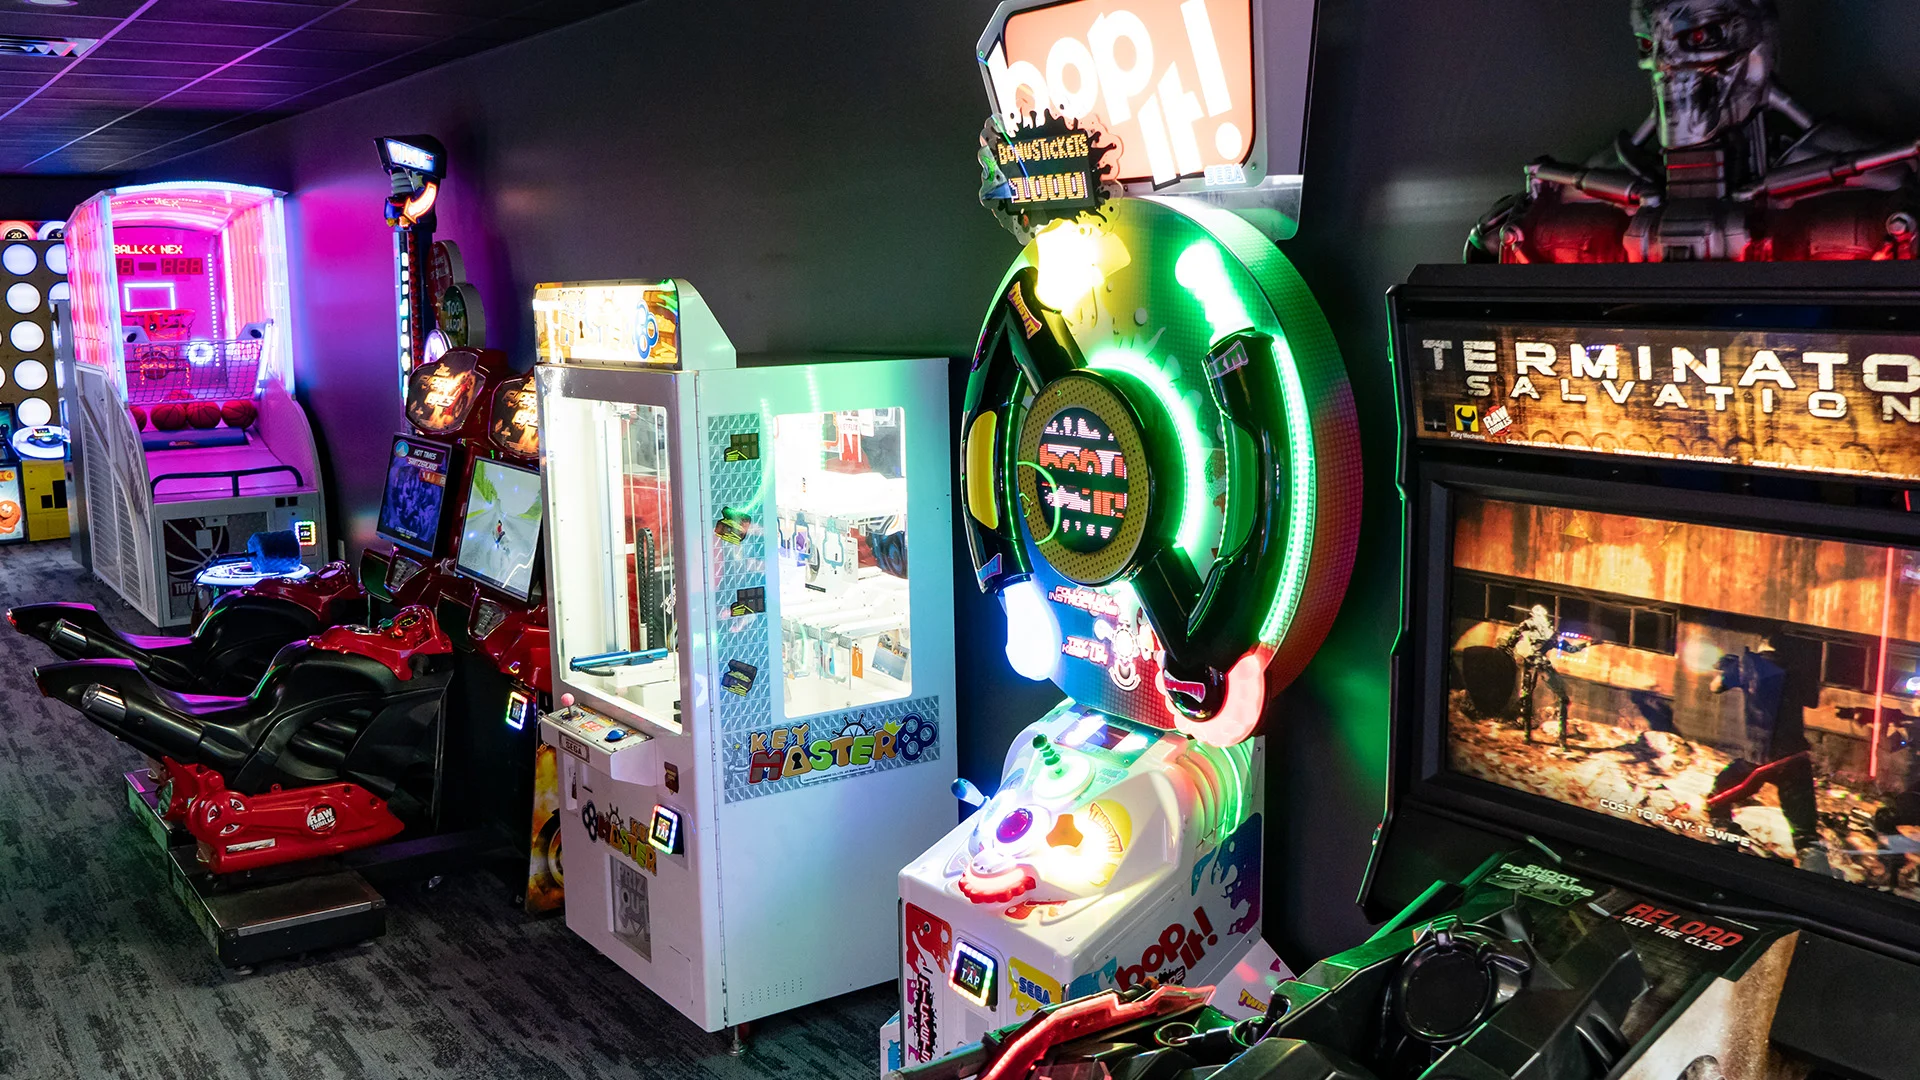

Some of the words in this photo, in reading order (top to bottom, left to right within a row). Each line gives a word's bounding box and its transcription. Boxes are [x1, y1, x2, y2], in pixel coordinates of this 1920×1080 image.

[1008, 171, 1088, 203] 1000
[1204, 164, 1246, 186] SEGA
[160, 244, 183, 255] NEX
[1422, 338, 1920, 394] TERMINATO
[1466, 375, 1920, 424] SALVATION
[1482, 405, 1509, 428] RAW
[1488, 417, 1514, 436] THRILLS
[413, 448, 424, 457] HOT
[565, 741, 582, 756] SEGA
[751, 723, 809, 753] KEY
[749, 730, 898, 784] MASTER
[309, 807, 333, 824] RAW
[1600, 798, 1633, 814] COST
[1636, 808, 1653, 820] TO
[1655, 814, 1696, 832] PLAY:
[1705, 828, 1751, 848] SWIPE
[619, 865, 648, 893] PRIZ
[1500, 862, 1558, 885] POWER
[1560, 881, 1596, 897] UPS
[1526, 864, 1580, 884] SHOOT
[1621, 915, 1652, 929] HIT
[1654, 925, 1684, 940] THE
[1684, 936, 1724, 952] CLIP
[1625, 903, 1744, 948] RELOAD
[1115, 922, 1186, 992] bop
[1180, 905, 1218, 970] it!
[961, 967, 981, 986] TAP
[1018, 976, 1051, 1005] SEGA
[1238, 988, 1269, 1014] TWIS
[918, 976, 931, 1064] TICKETS
